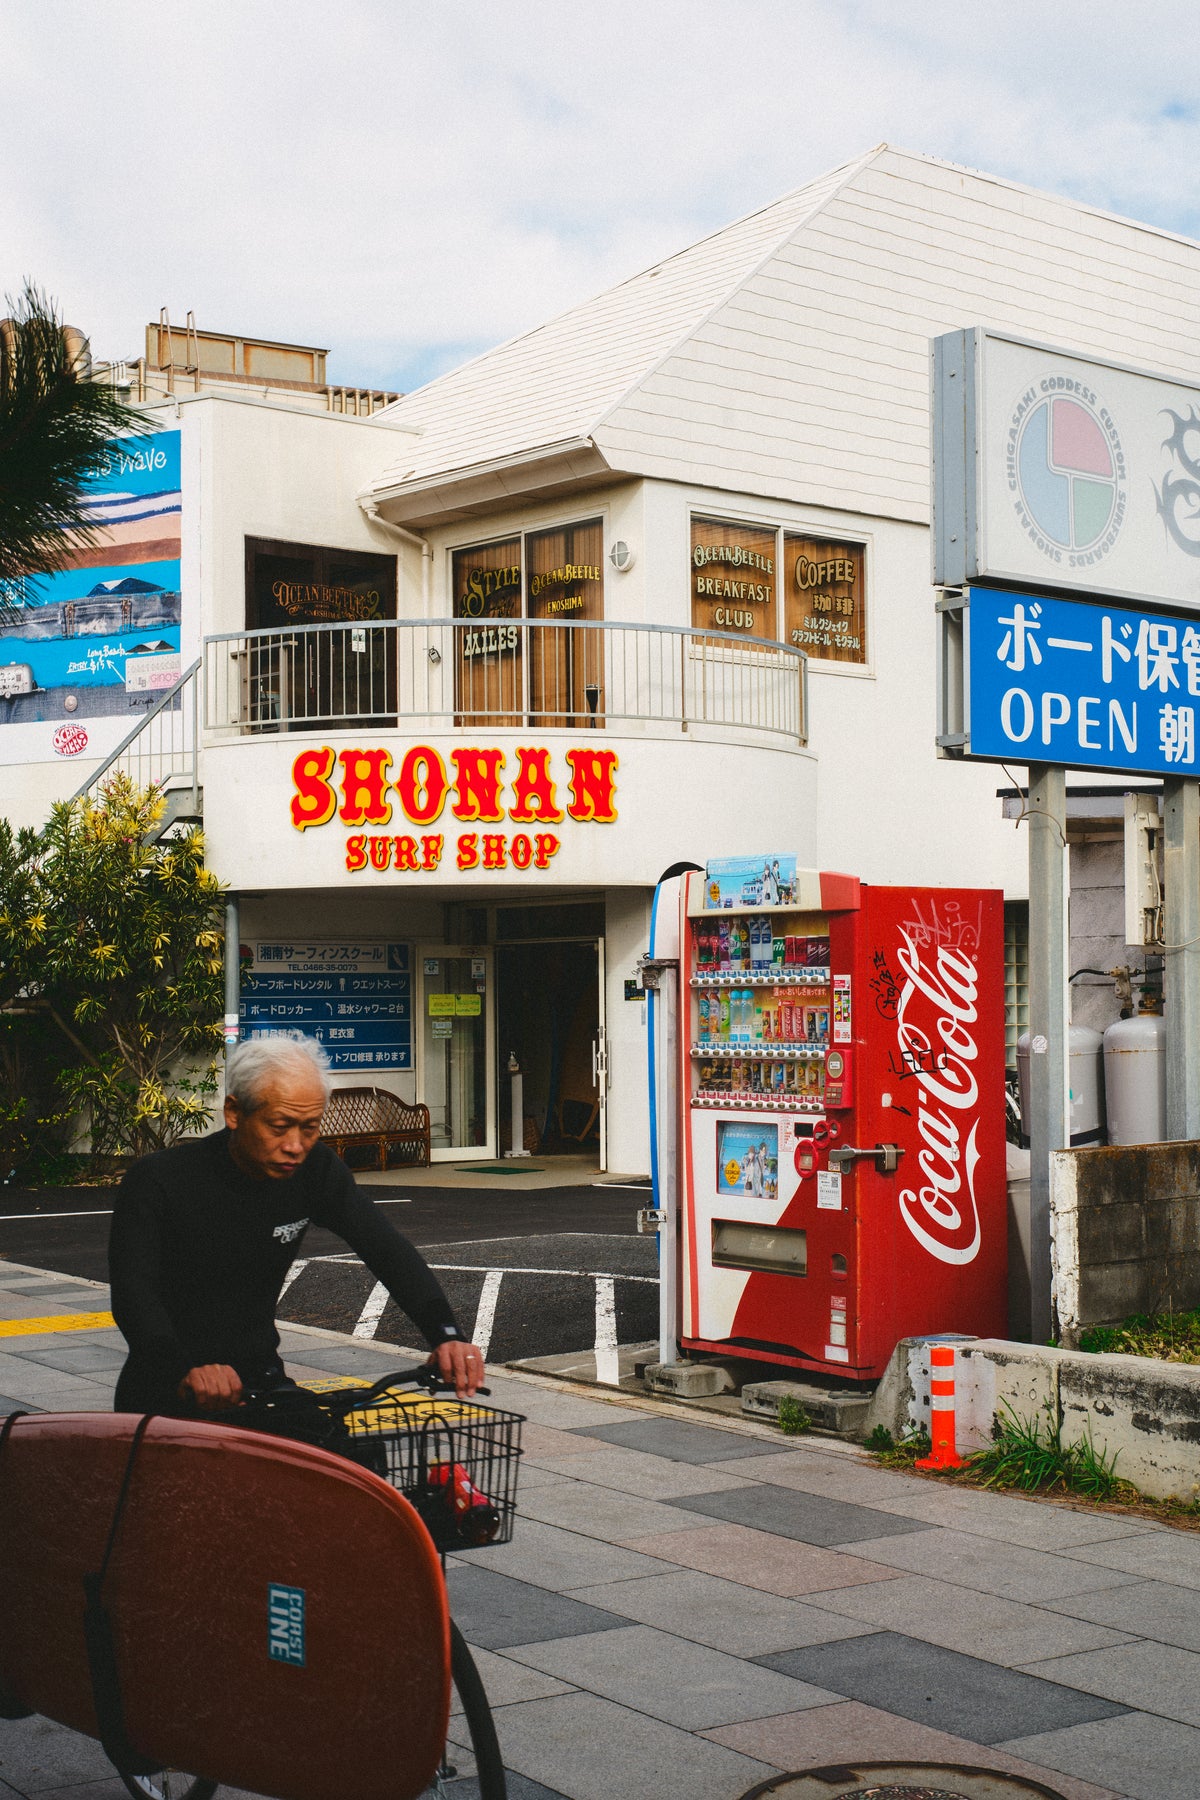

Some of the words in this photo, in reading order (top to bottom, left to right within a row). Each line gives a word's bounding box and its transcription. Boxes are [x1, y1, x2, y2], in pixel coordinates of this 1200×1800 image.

[1039, 376, 1098, 406] GODDESS
[1006, 387, 1037, 491] CHIGASAKI
[1099, 407, 1126, 481] CUSTOM
[1014, 500, 1062, 564] SHONAN
[1068, 490, 1127, 568] SURFBOARDS
[462, 565, 519, 618] STYLE
[563, 563, 601, 584] BEETLE
[696, 576, 772, 603] BREAKFAST
[796, 555, 855, 590] COFFEE
[547, 596, 583, 614] ENOSHIMA
[715, 607, 754, 628] CLUB
[803, 616, 848, 633] ミルクシェイク
[464, 626, 518, 657] MILES
[1001, 687, 1137, 754] OPEN
[1158, 702, 1195, 764] 朝
[290, 745, 620, 832] SHONAN
[345, 833, 444, 872] SURF
[456, 832, 560, 871] SHOP
[260, 945, 383, 960] 湘南サーフィンスクール
[250, 1004, 313, 1015] ボードロッカー
[897, 925, 981, 1265] Coca-Cola
[270, 1589, 290, 1658] LINE
[289, 1593, 303, 1662] COAST
